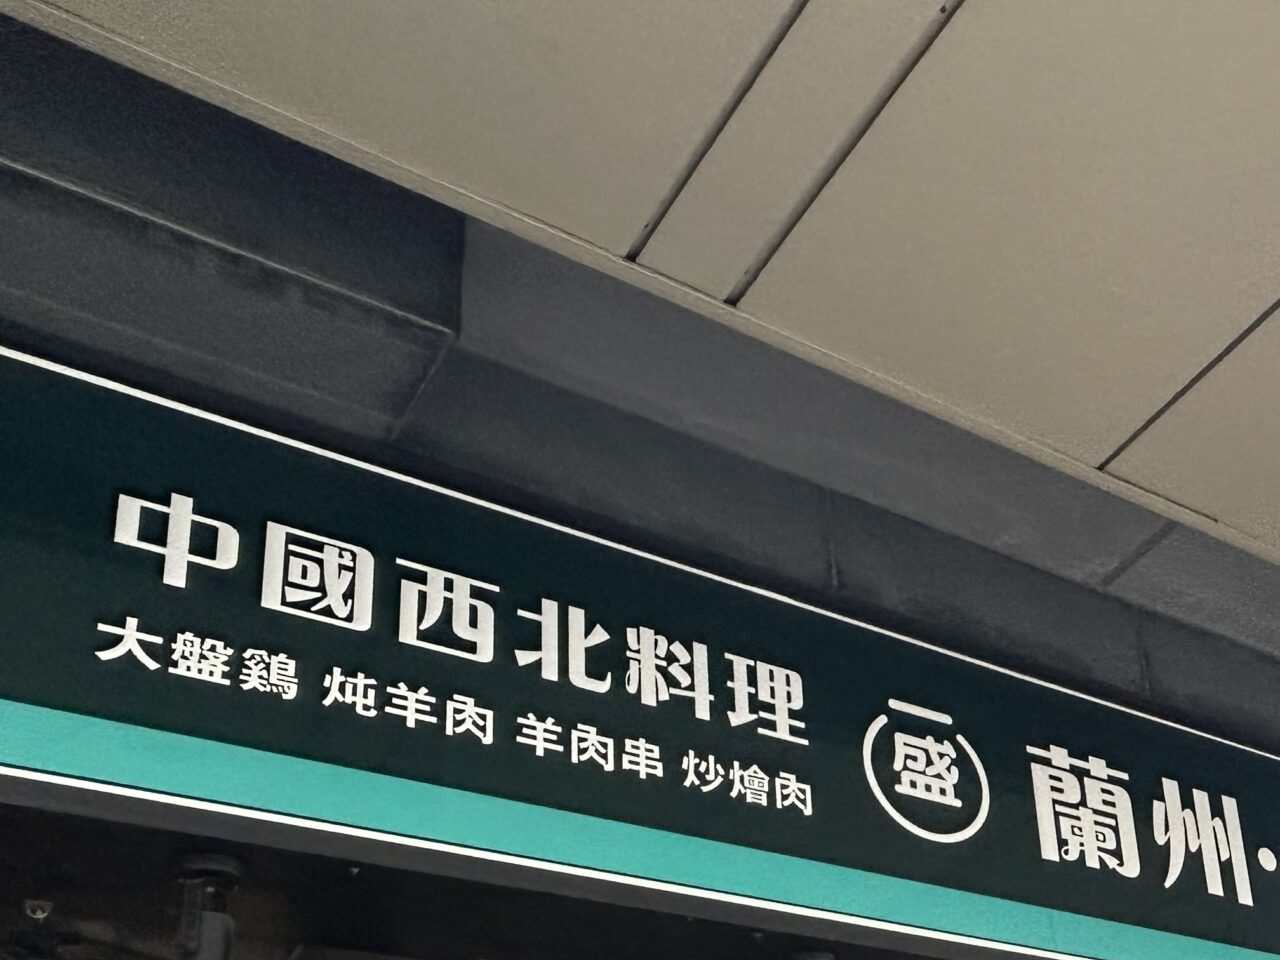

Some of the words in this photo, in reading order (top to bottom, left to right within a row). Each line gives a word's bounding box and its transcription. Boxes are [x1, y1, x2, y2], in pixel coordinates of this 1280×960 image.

[113, 491, 811, 746] 中國西北料理
[323, 667, 495, 745] 炖羊肉
[516, 713, 665, 780] 羊肉串
